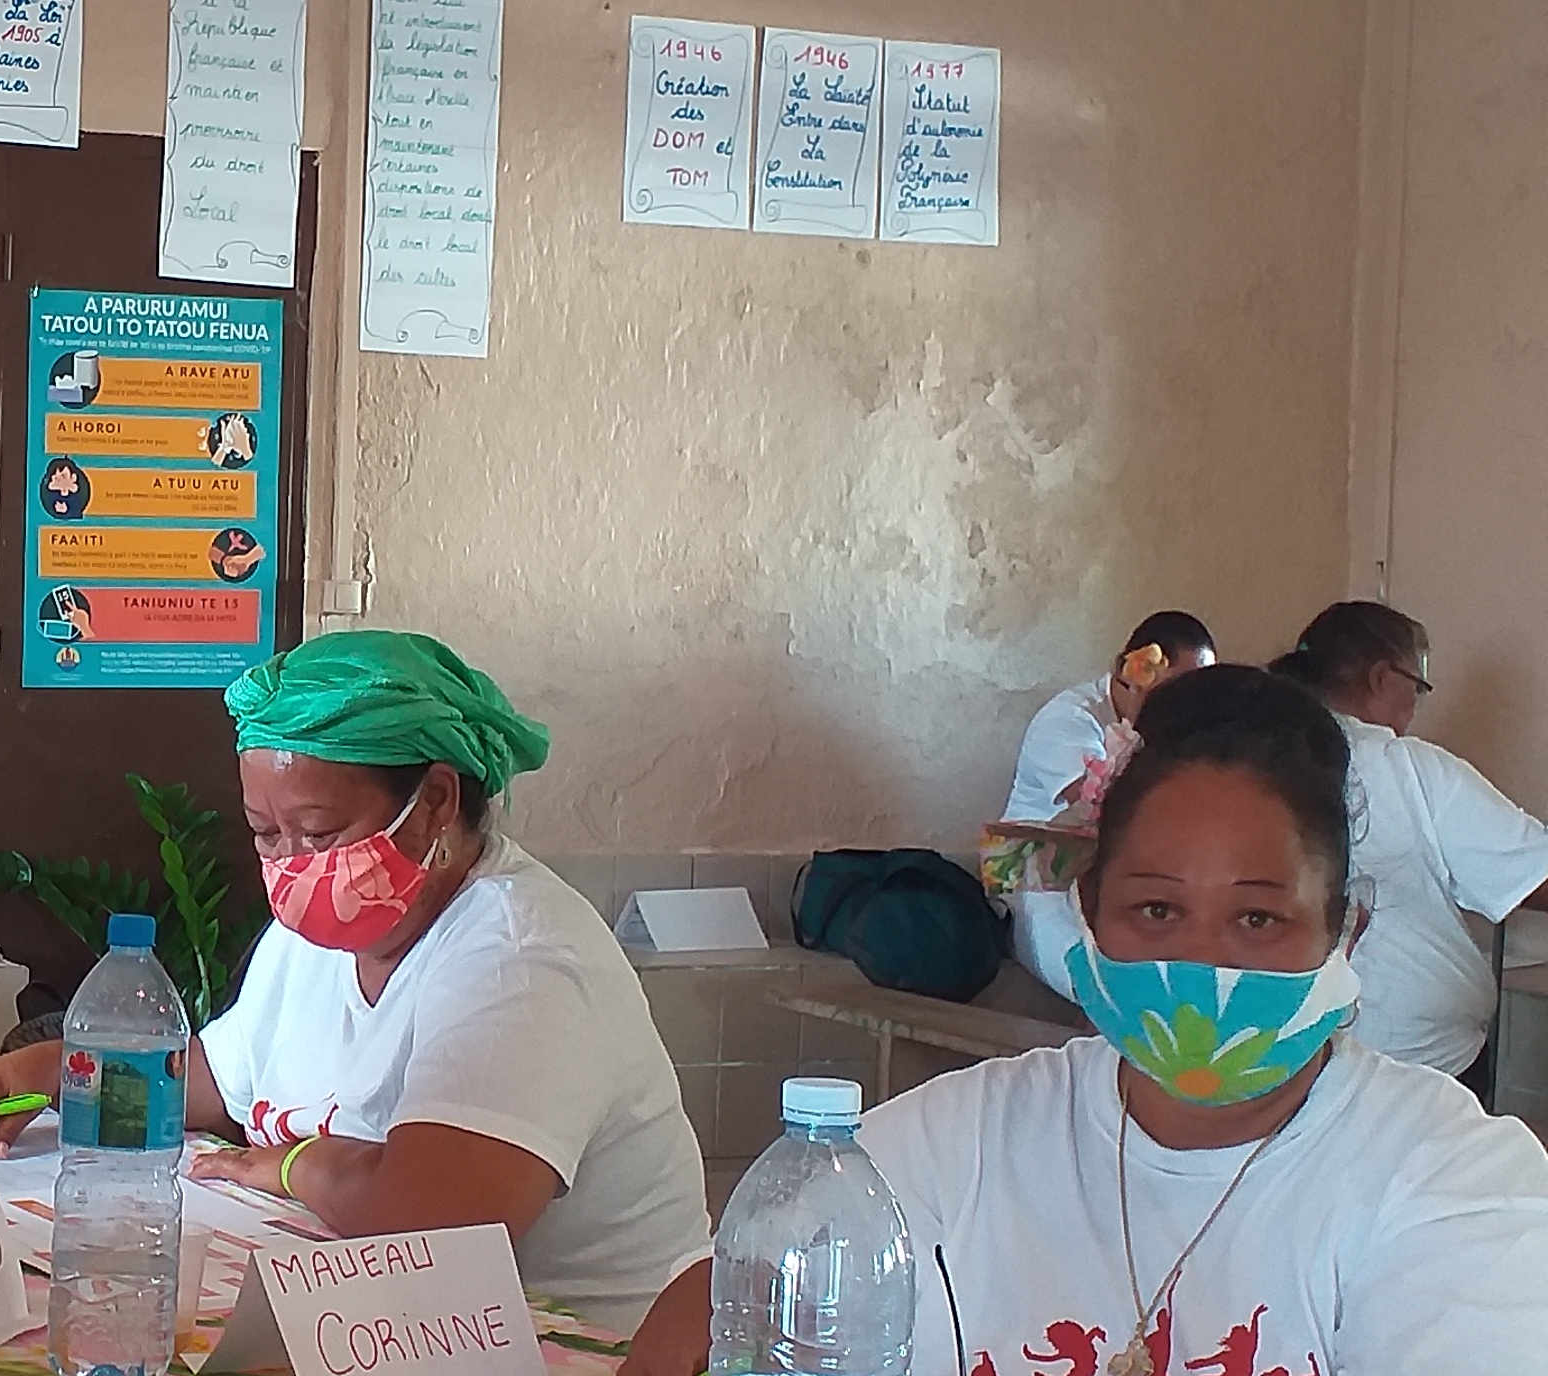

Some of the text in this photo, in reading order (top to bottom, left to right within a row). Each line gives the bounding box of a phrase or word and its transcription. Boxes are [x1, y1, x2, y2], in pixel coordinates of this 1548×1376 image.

[1, 24, 44, 43] 1905
[659, 38, 722, 61] 1946
[793, 45, 849, 70] 1946
[911, 61, 963, 79] 1977
[655, 69, 730, 98] Création
[912, 84, 971, 113] Statut
[670, 100, 705, 120] des
[653, 127, 733, 156] DOM et
[666, 167, 709, 187] TOM
[84, 297, 227, 320] A PARURU AMUI
[41, 315, 269, 341] TATOU I TO TATOU FENUA
[165, 365, 250, 380] A RAVE ATU
[57, 421, 122, 434] A HOROI
[153, 478, 162, 489] A
[123, 597, 239, 609] TANIUNIU TE 15
